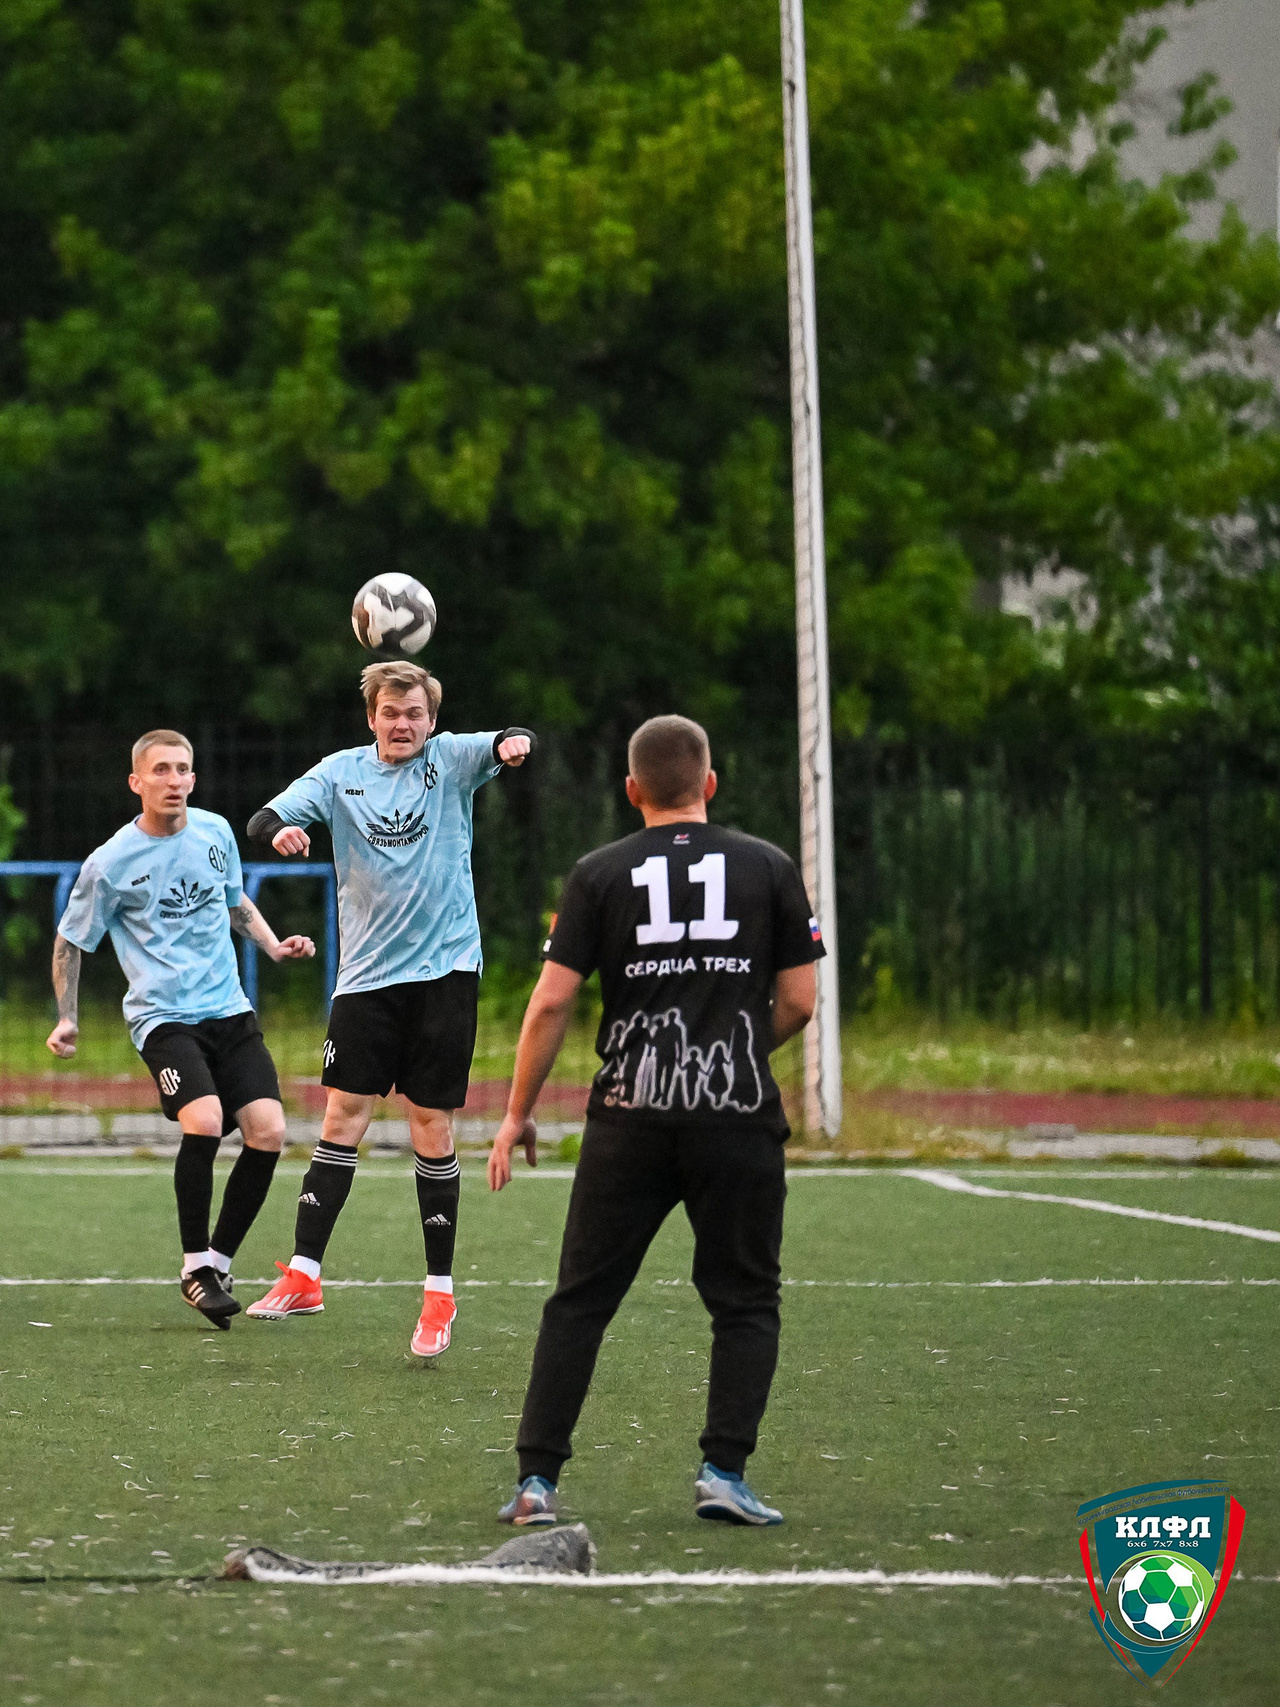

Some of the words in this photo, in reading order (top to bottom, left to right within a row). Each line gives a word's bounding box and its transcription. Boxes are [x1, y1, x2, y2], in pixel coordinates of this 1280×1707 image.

[631, 852, 739, 945] 11
[625, 956, 697, 978] СЕРДЦА
[702, 956, 751, 974] ТРЕХ
